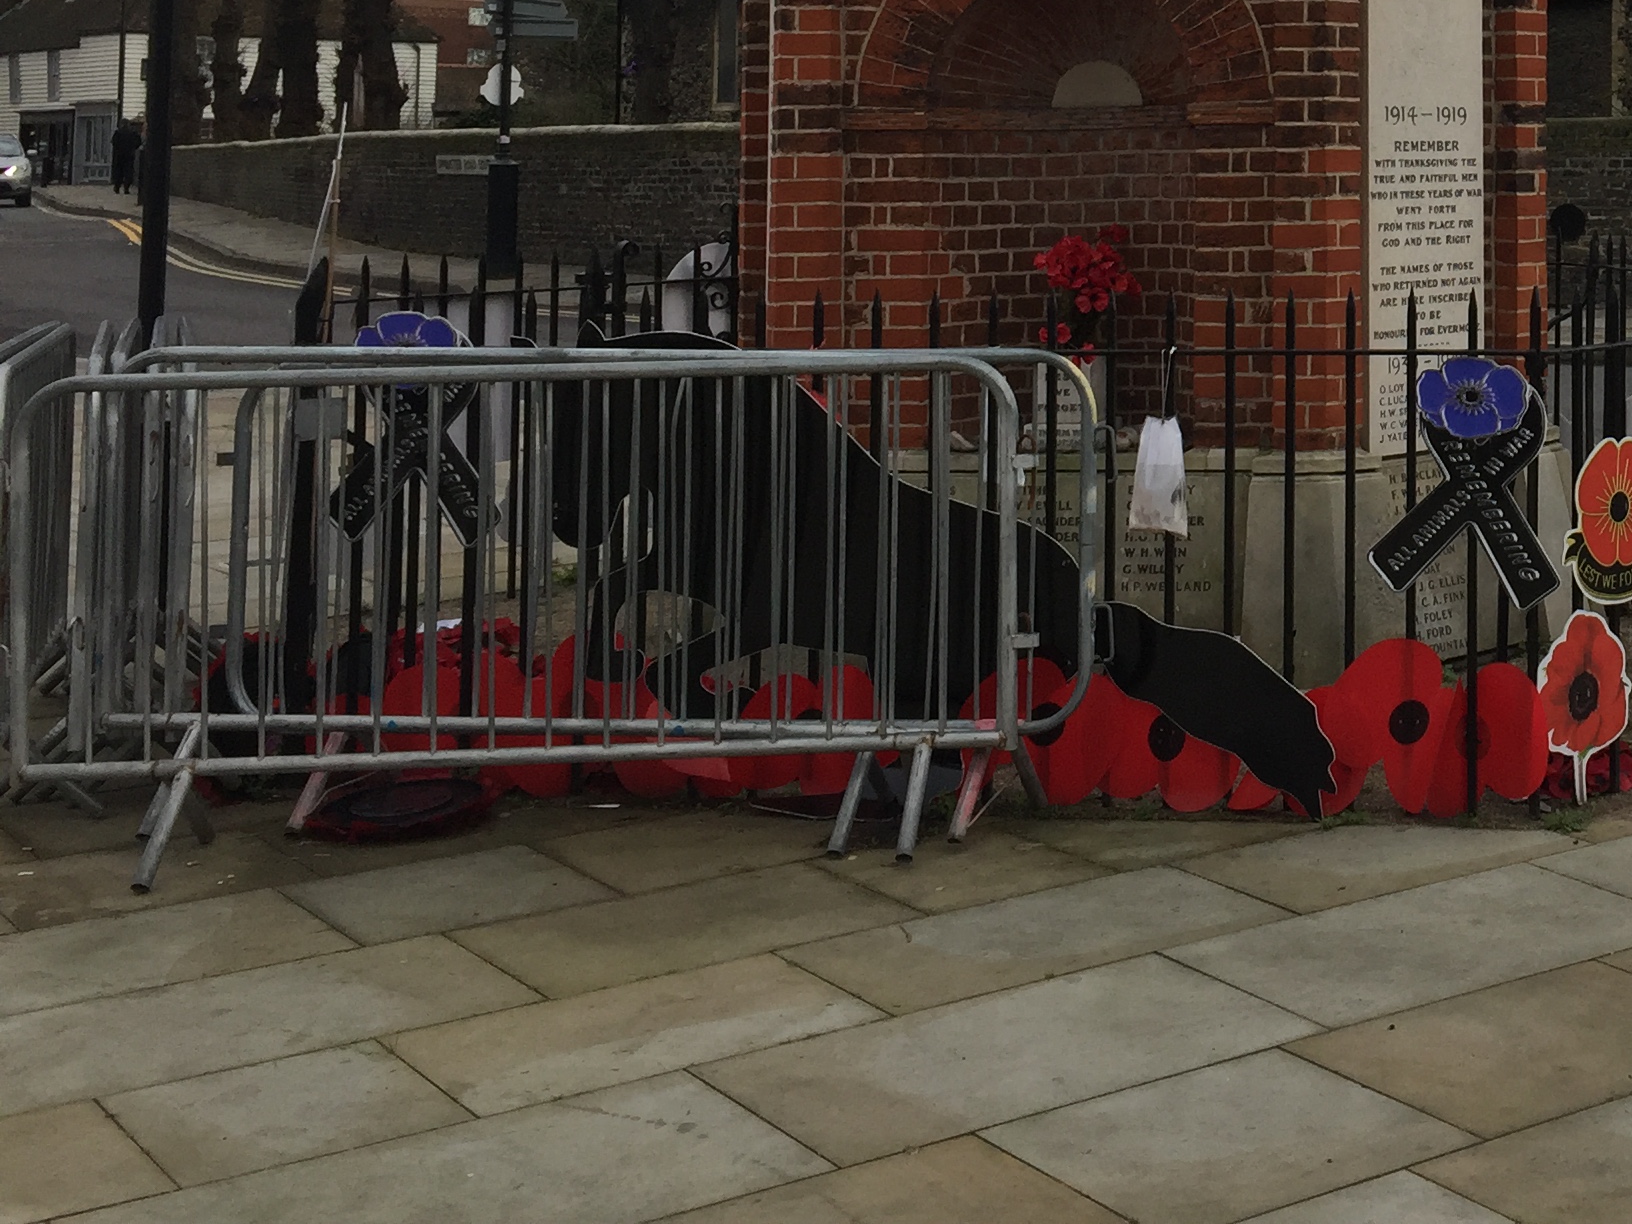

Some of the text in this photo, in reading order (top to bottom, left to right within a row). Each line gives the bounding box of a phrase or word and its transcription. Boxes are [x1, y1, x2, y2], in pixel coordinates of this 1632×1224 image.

[1394, 140, 1459, 152] REMEMBER
[1375, 158, 1477, 168] WITH THANKSGIVING THE
[1373, 173, 1478, 184] TRUE AND FAITHFUL MEN
[1370, 188, 1482, 200] WHO IN THESE YEARS OF WAR
[1396, 205, 1456, 215] WENT FORTH
[1378, 219, 1473, 232] FROM THIS PLACE FOR
[1382, 235, 1471, 247] GOD AND THE RIGHT
[1380, 262, 1474, 276] THE NAMES OF THOSE
[1372, 276, 1480, 291] WHO RETURNED NOT AGAIN
[1380, 298, 1397, 308] ARE
[1401, 296, 1424, 305] HRE
[1429, 310, 1442, 320] BE
[1420, 327, 1435, 336] FOR
[1388, 546, 1417, 571] ALL
[1413, 490, 1471, 547] ANIMALS
[1483, 457, 1505, 475] IN
[1499, 427, 1535, 458] WAR
[1441, 440, 1540, 581] REMEMBERING
[1579, 558, 1602, 588] LEST
[1602, 574, 1617, 590] WE
[1440, 575, 1466, 588] ELLIS
[1424, 609, 1453, 624] FOLEY
[1426, 625, 1452, 639] FORD
